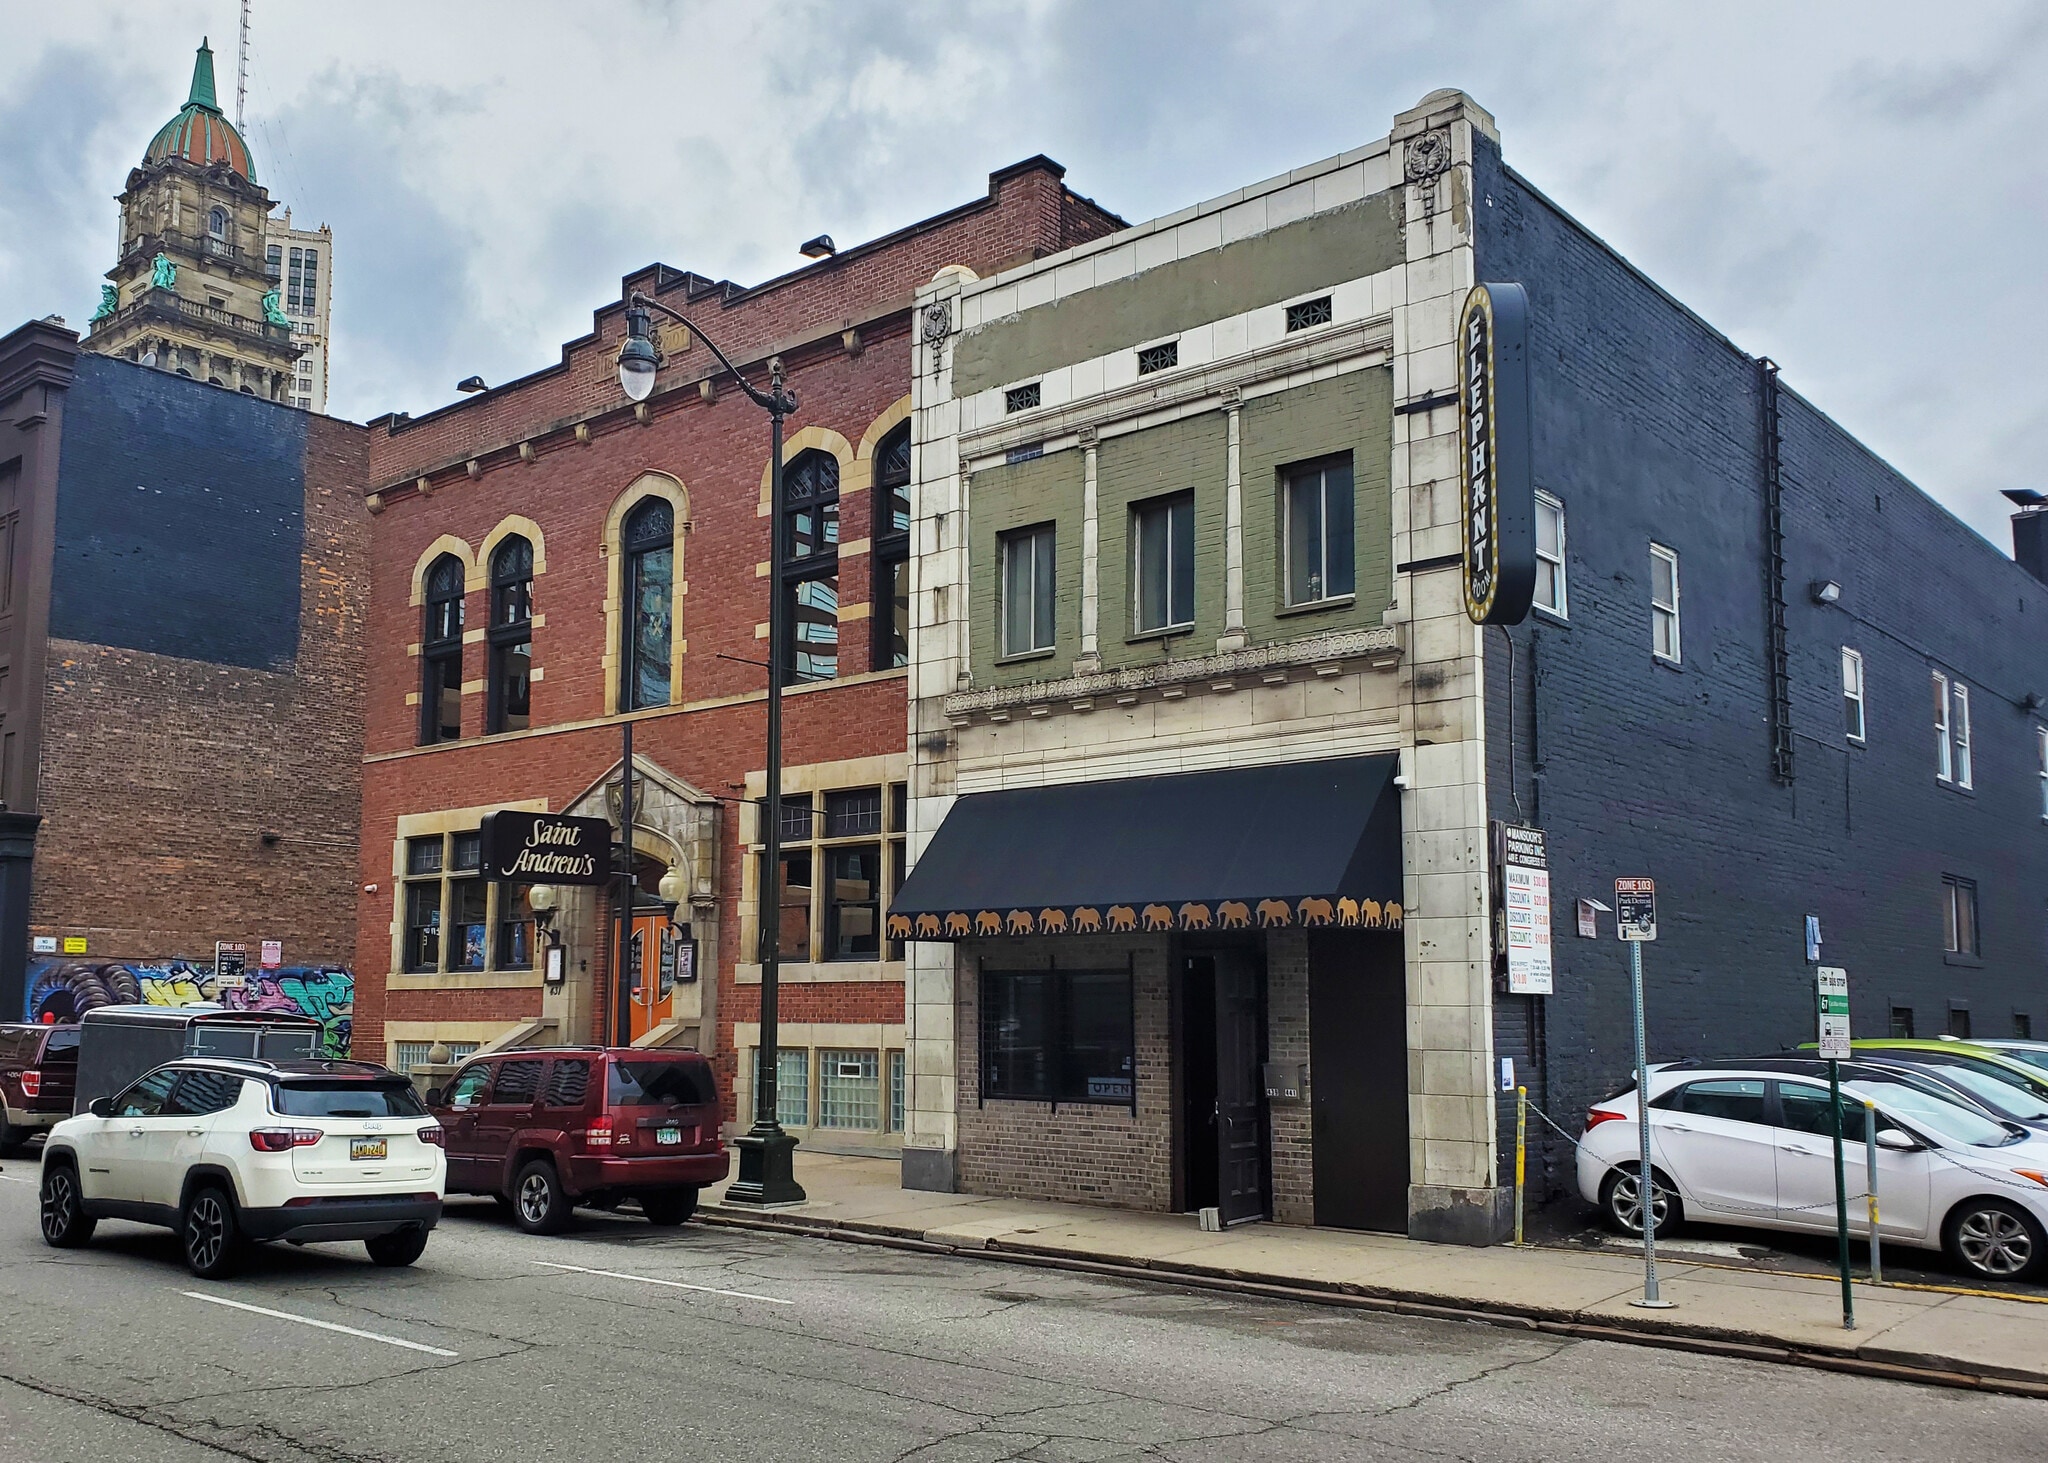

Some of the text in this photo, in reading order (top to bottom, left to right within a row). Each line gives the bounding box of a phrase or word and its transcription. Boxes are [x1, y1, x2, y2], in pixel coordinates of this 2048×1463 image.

[1469, 315, 1487, 572] ELEPHANT
[1472, 569, 1491, 597] ROOM
[525, 819, 581, 847] Saint
[1511, 828, 1542, 844] MANSOOR'S
[1507, 840, 1546, 857] PARKING INC.
[501, 848, 596, 876] Andrew's
[1519, 855, 1540, 867] CONGRESS
[1508, 872, 1530, 886] MAXIMUM
[1618, 881, 1651, 890] ZONE 103
[1509, 891, 1526, 904] DISCOUNT
[1509, 911, 1527, 924] DISCOUNT
[1534, 913, 1548, 926] $15.00
[1510, 931, 1527, 943] DISCOUNT
[219, 943, 246, 951] ZONE 103
[1836, 978, 1846, 988] STOP
[1821, 996, 1828, 1010] 67
[1093, 1083, 1129, 1094] OPEN
[363, 1121, 383, 1130] Jeep
